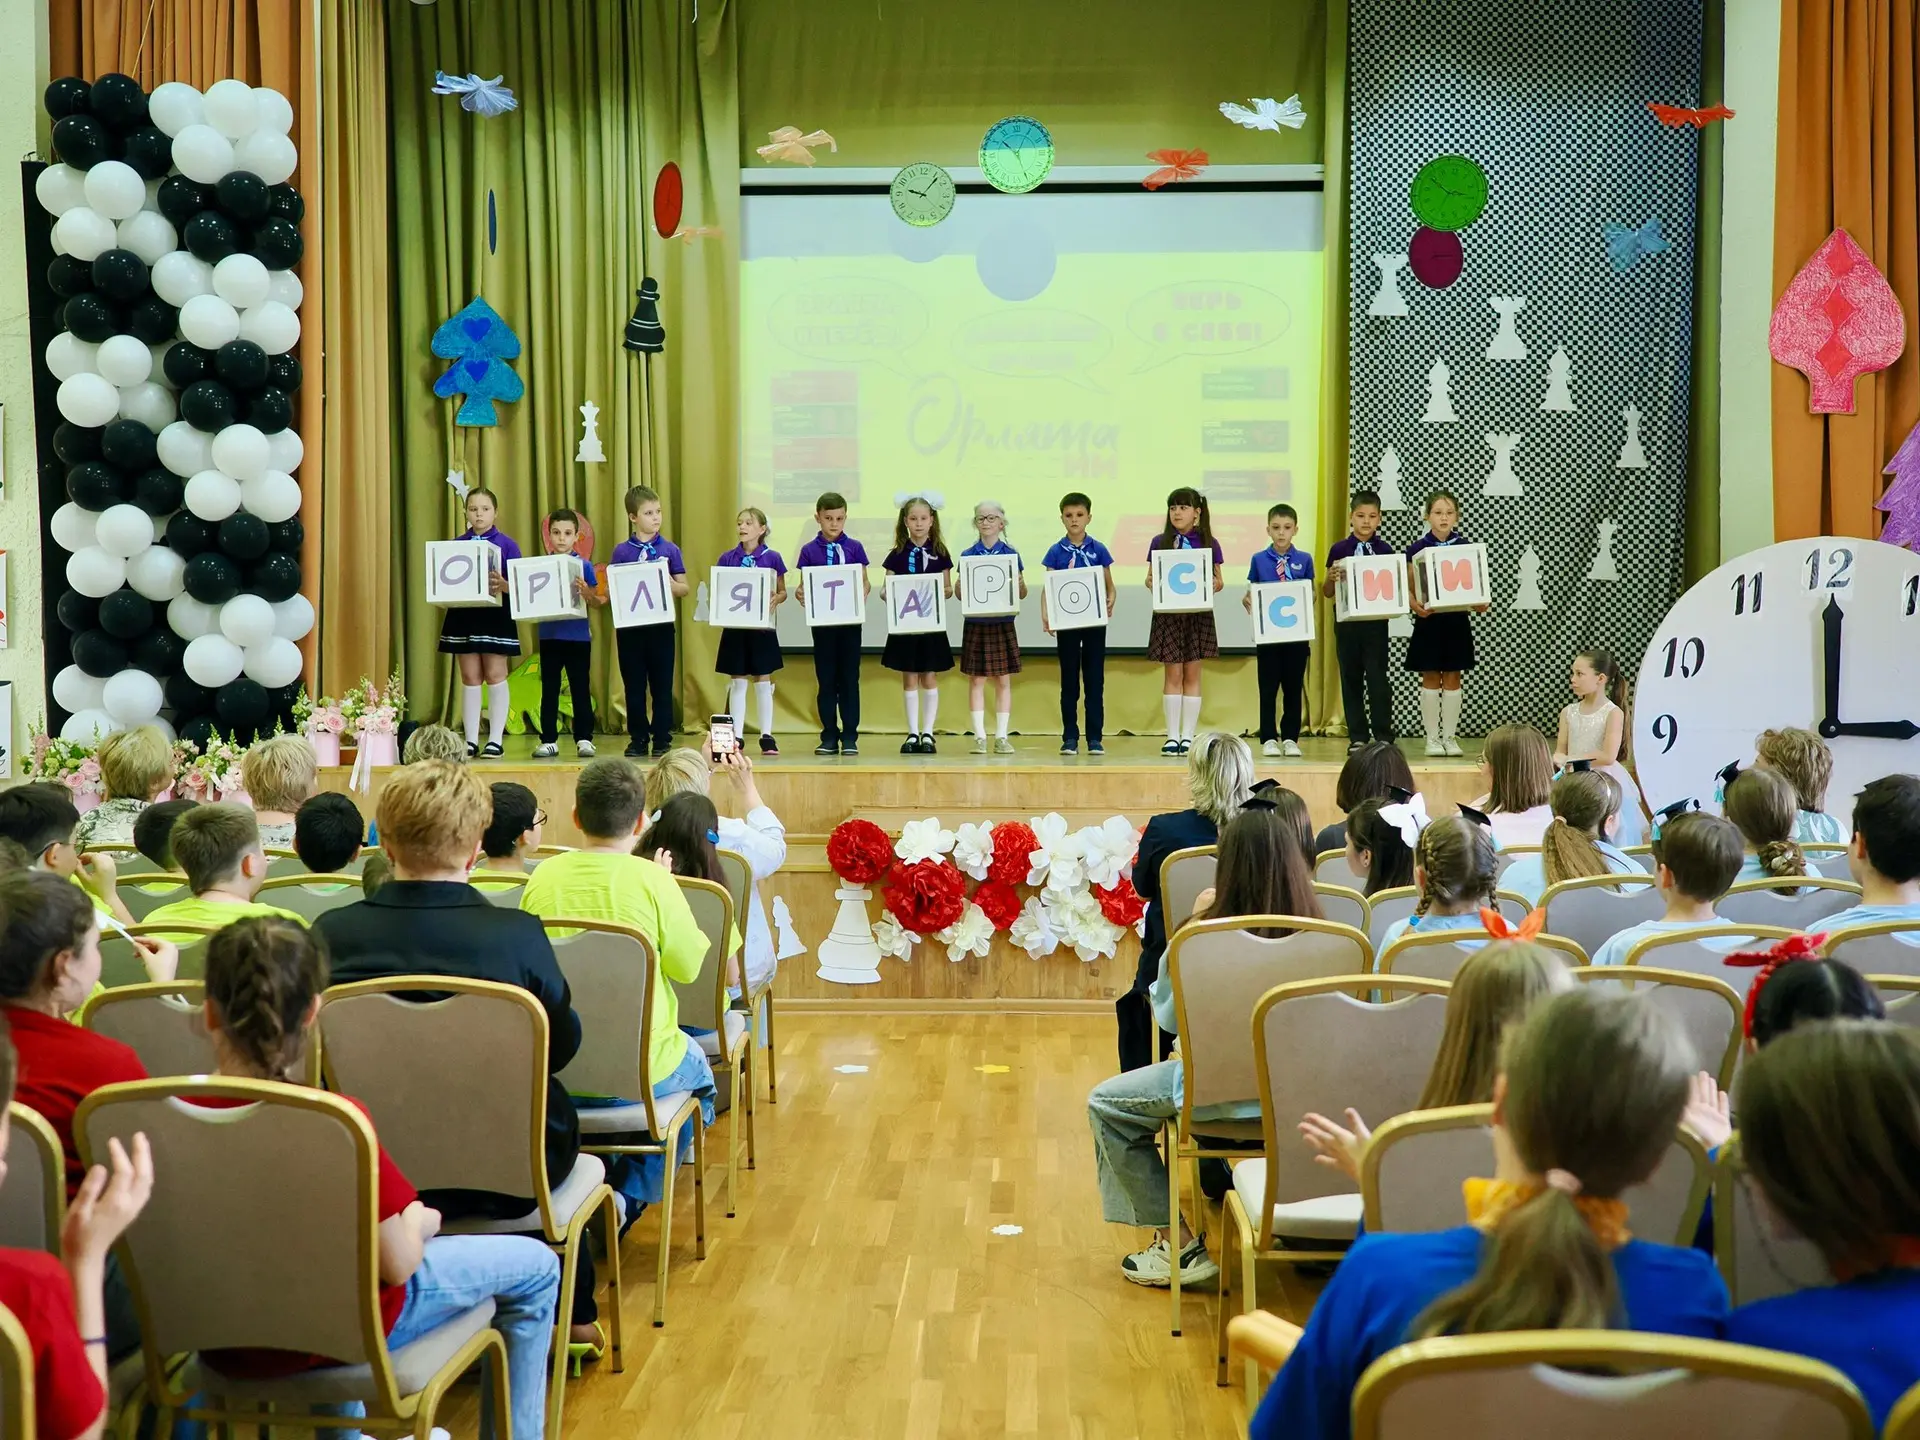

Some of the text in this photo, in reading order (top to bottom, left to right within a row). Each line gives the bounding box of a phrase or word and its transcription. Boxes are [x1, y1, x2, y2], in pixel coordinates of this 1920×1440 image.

[906, 371, 1120, 468] Орлята
[1805, 548, 1853, 590] 12
[1731, 571, 1763, 616] 11
[1661, 636, 1706, 679] 10
[1651, 713, 1679, 755] 9
